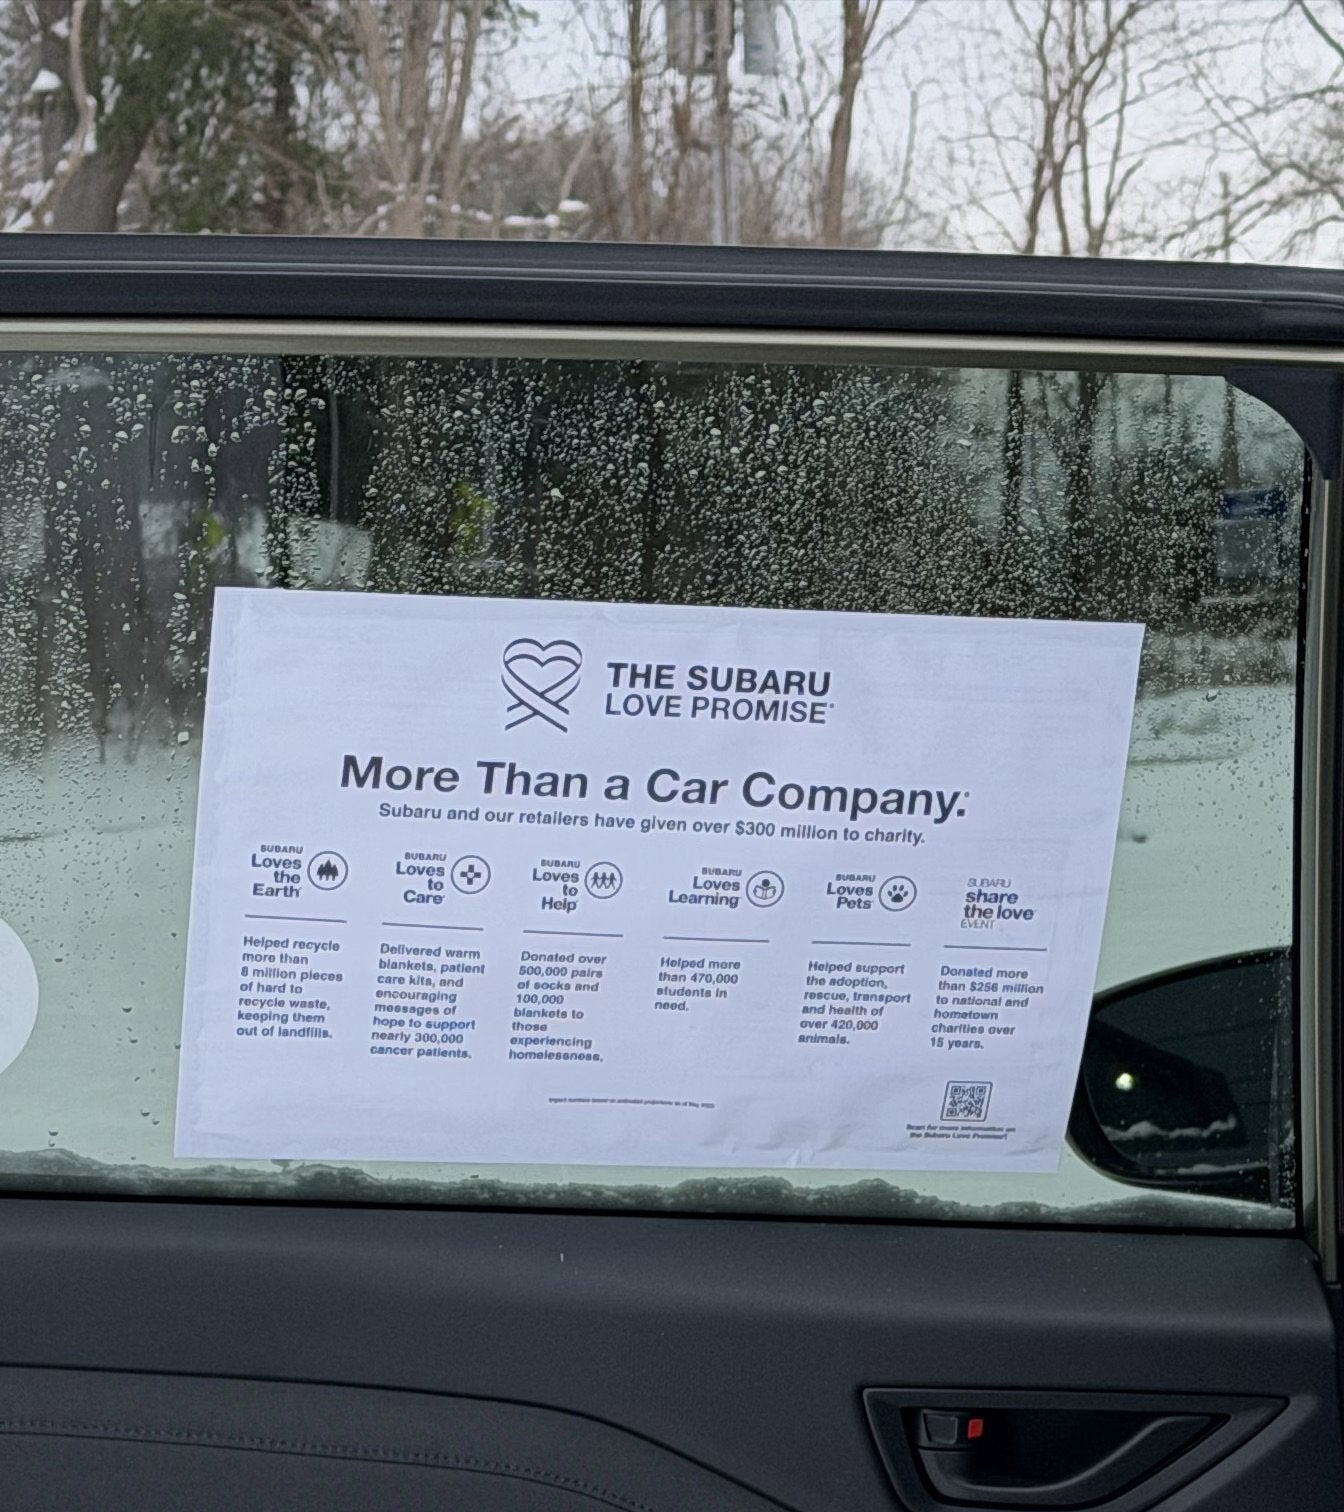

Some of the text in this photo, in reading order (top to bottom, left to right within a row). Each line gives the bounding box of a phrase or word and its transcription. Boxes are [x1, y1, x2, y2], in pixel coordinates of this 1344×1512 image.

[606, 662, 831, 697] THE SUBARU
[605, 693, 826, 724] LOVE PROMISE
[341, 755, 966, 824] More Than a Car Company.
[379, 803, 925, 847] Subaru and our retailers have given over $300 million to charity.
[261, 844, 303, 854] SUBARU
[252, 854, 302, 870] Loves
[405, 852, 446, 861] SUBARU
[396, 862, 445, 876] Loves
[541, 859, 580, 868] SUBARU
[274, 871, 301, 884] the
[533, 868, 579, 883] Loves
[702, 868, 742, 876] SUBARU
[836, 874, 876, 882] SUBARU
[428, 878, 444, 891] to
[693, 876, 740, 891] Loves
[827, 882, 873, 896] Loves
[967, 878, 1011, 887] SUBARU
[252, 883, 300, 897] Earth
[563, 883, 578, 896] to
[403, 890, 443, 904] Care
[669, 890, 739, 908] Learning
[837, 897, 872, 910] Pets
[966, 890, 1018, 904] share
[542, 897, 577, 914] Help
[964, 904, 1034, 920] the love
[961, 920, 995, 929] EVENT
[244, 936, 340, 952] Helped recycle
[380, 943, 480, 959] Delivered warm
[521, 951, 606, 964] Donated over
[242, 953, 308, 964] more than
[661, 958, 741, 970] Helped more
[378, 959, 485, 975] blankets, patient
[519, 966, 603, 979] 500,000 pairs
[808, 961, 905, 975] Helped support
[941, 966, 1028, 979] Donated more
[241, 967, 343, 982] 8 million pieces
[377, 975, 464, 987] care kits, and
[659, 973, 738, 985] than 470,000
[240, 982, 303, 994] of hard to
[517, 981, 599, 992] of socks and
[806, 976, 888, 989] the adoption,
[938, 981, 965, 991] than
[1002, 984, 1044, 994] million
[376, 989, 457, 1003] encouraging
[657, 987, 727, 998] students in
[804, 992, 911, 1004] rescue, transport
[239, 997, 330, 1010] recycle waste,
[516, 994, 564, 1005] 100,000
[655, 1001, 689, 1011] need.
[936, 995, 1029, 1007] to national and
[375, 1003, 456, 1016] messages of
[514, 1007, 584, 1019] blankets to
[802, 1005, 884, 1016] and health of
[934, 1009, 998, 1020] hometown
[237, 1010, 325, 1024] keeping them
[373, 1016, 475, 1031] hope to support
[512, 1022, 547, 1031] those
[800, 1021, 827, 1029] over
[932, 1023, 1015, 1035] charities over
[237, 1026, 332, 1038] out of landfills.
[371, 1032, 464, 1044] nearly 300,000
[510, 1036, 592, 1049] experiencing
[798, 1034, 850, 1044] animals.
[930, 1037, 984, 1050] 15 years.
[370, 1046, 472, 1059] cancer patients.
